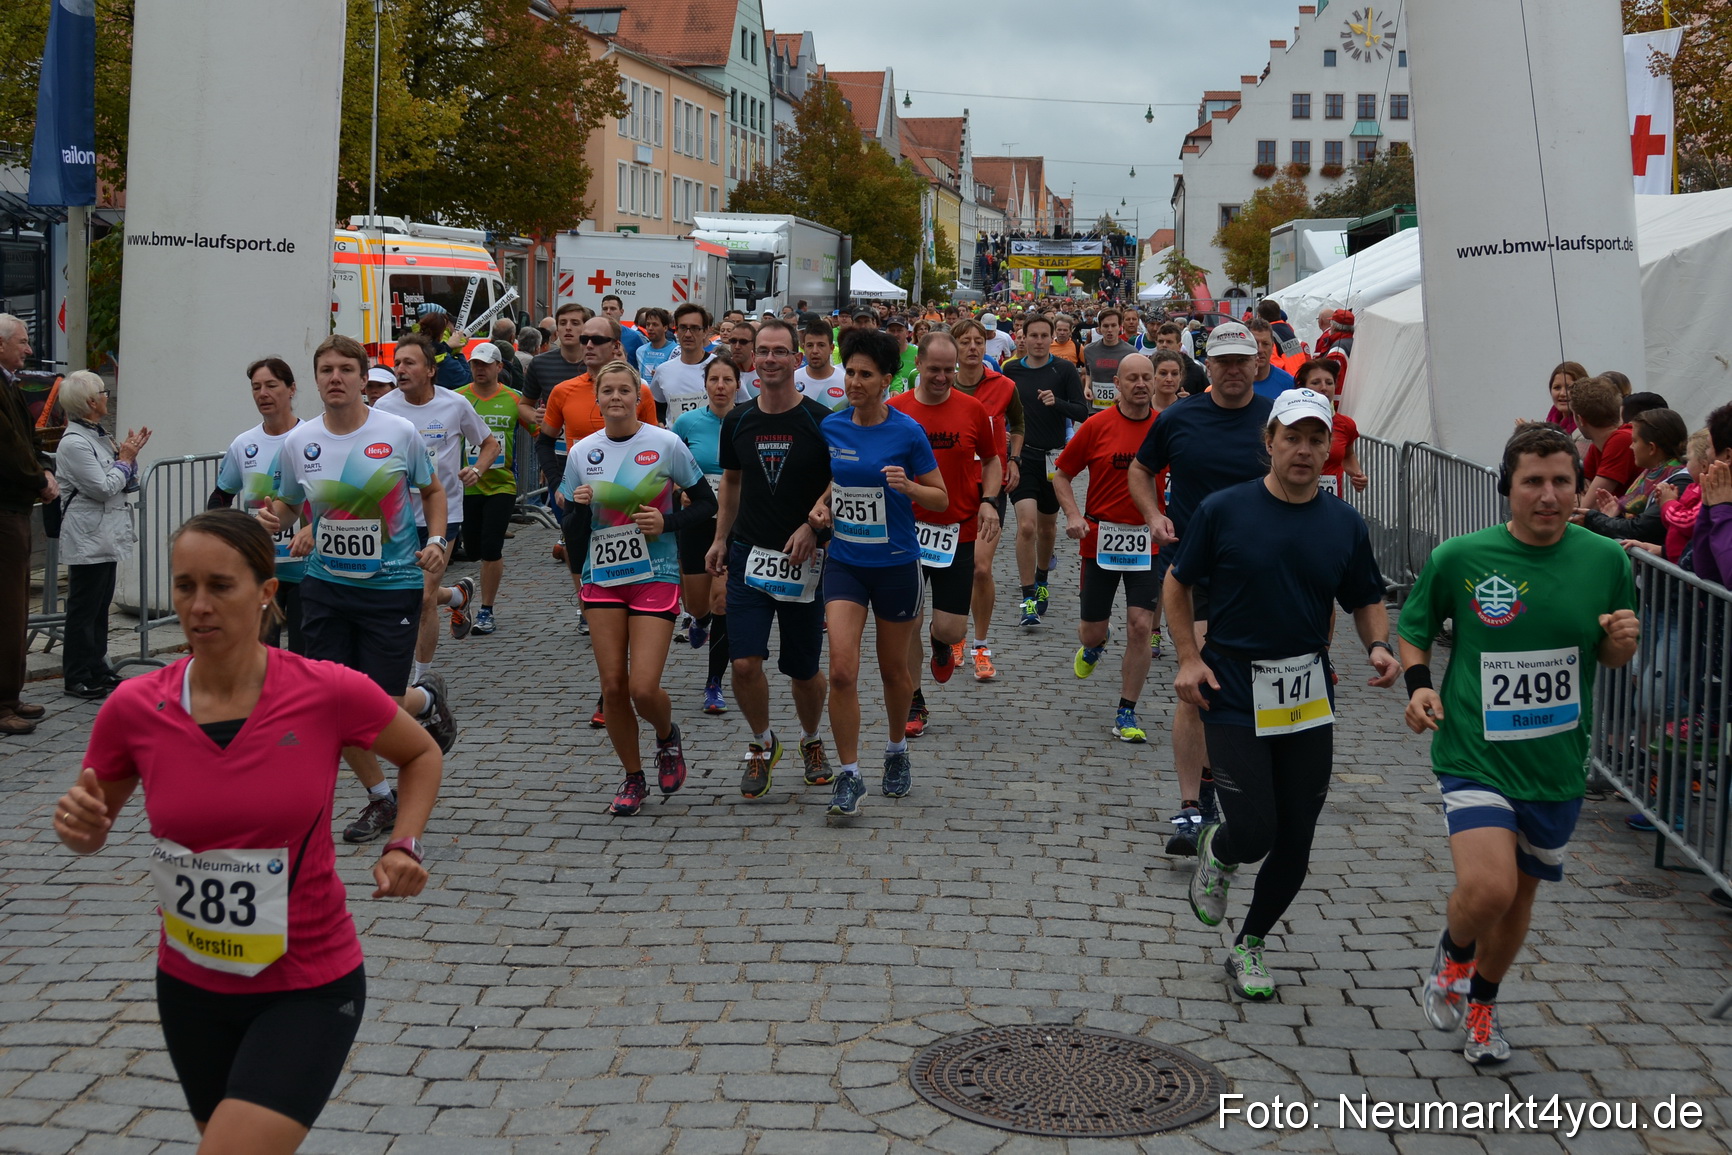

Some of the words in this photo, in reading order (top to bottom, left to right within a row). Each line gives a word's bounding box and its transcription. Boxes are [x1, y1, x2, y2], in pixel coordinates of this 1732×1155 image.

[127, 231, 295, 253] www.bmw-laufsport.de
[1456, 235, 1634, 259] www.bmw-laufsport.de
[1038, 258, 1071, 267] START
[615, 269, 660, 279] Bayerisches
[615, 279, 636, 287] Rotes
[614, 288, 636, 296] Kreuz
[462, 289, 474, 310] BMW
[468, 293, 515, 333] bmw-laufsport.de
[1097, 389, 1114, 400] 285
[755, 434, 793, 442] FINISHER
[367, 445, 390, 457] Hervis
[757, 442, 790, 450] BRAVEHEART
[637, 452, 658, 463] Hervis
[304, 462, 322, 470] PARTL
[835, 497, 877, 522] 2551
[606, 530, 633, 539] Neumarkt
[842, 524, 870, 536] Claudia
[1118, 525, 1143, 533] Neumarkt
[321, 532, 375, 557] 2660
[1103, 533, 1147, 552] 2239
[594, 537, 643, 565] 2528
[921, 550, 946, 561] dreas
[330, 559, 367, 571] Clemens
[1109, 555, 1138, 565] Michael
[605, 565, 635, 578] Yvonne
[753, 557, 803, 581] 2598
[764, 582, 786, 593] Frank
[1477, 611, 1516, 625] ROSARYVILLE
[1483, 660, 1515, 670] PARTL
[1517, 658, 1563, 669] Neumarkt
[1271, 670, 1312, 705] 147
[1492, 669, 1571, 706] 2498
[1290, 708, 1302, 722] Uli
[1512, 712, 1554, 727] Rainer
[191, 857, 261, 874] Neumarkt
[175, 873, 257, 928] 283
[186, 928, 244, 958] Kerstin
